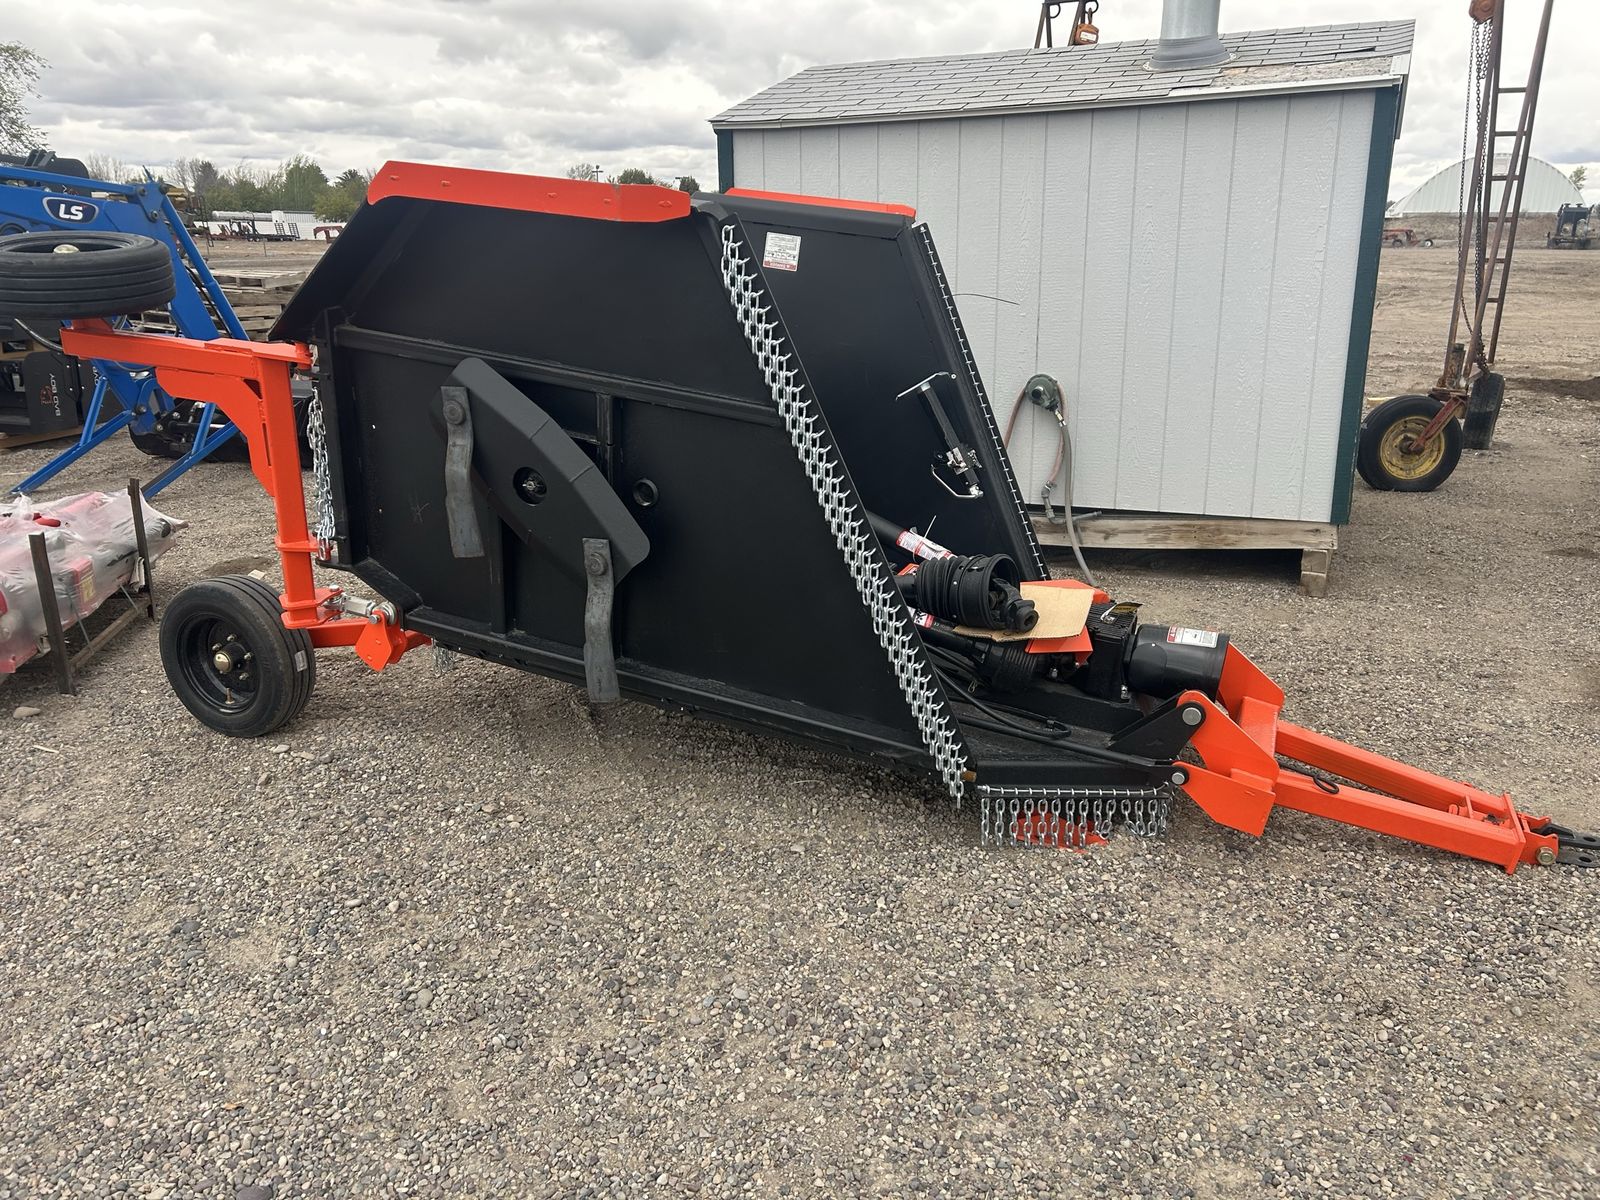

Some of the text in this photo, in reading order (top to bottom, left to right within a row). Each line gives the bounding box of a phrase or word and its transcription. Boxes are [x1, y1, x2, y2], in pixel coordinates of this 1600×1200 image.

[58, 204, 83, 221] LS
[49, 373, 61, 417] BAD BOY
